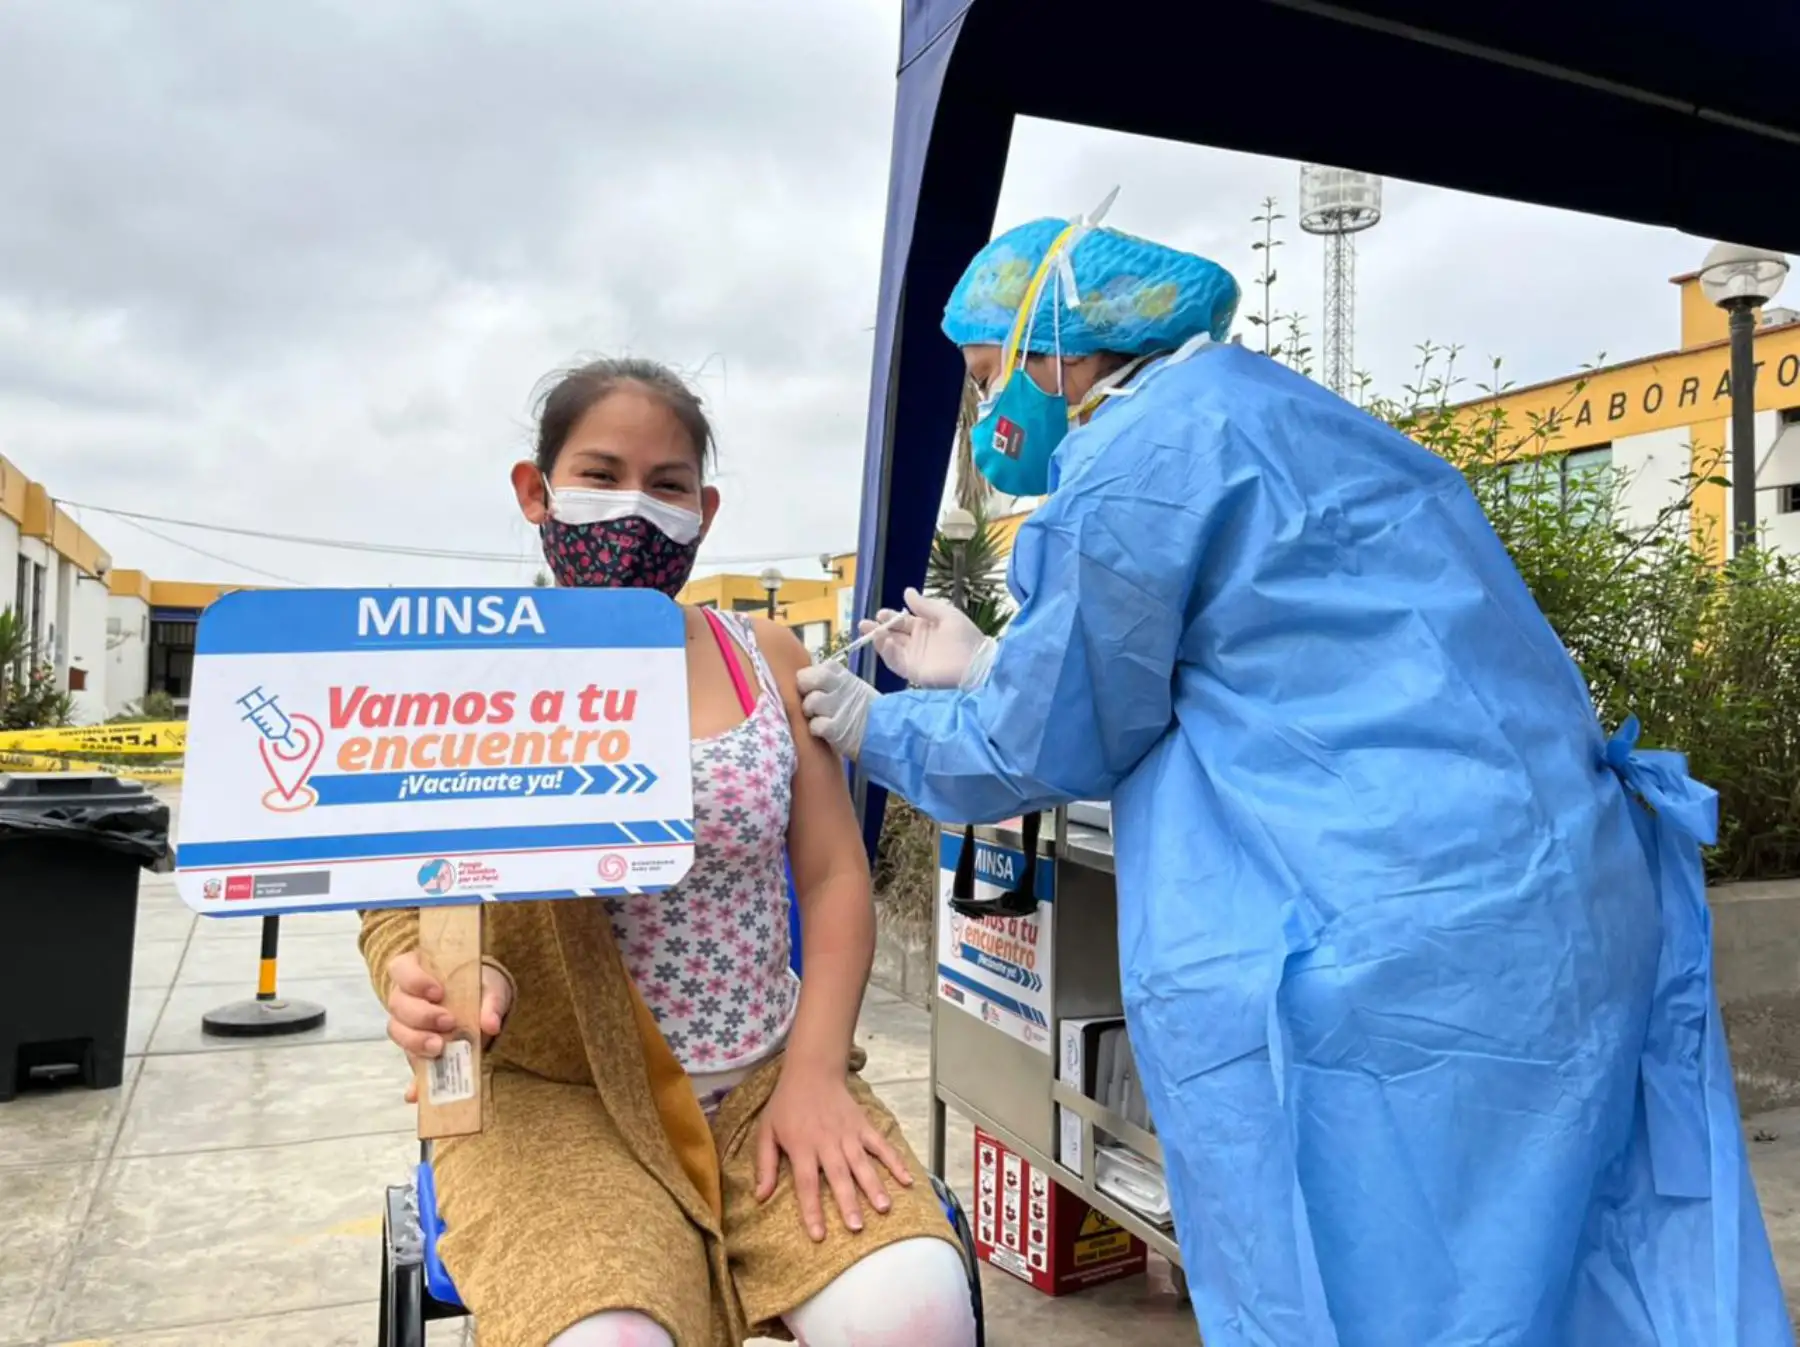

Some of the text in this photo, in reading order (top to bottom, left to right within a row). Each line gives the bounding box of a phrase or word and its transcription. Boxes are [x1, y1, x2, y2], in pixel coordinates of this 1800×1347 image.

[357, 595, 547, 636] MINSA
[328, 683, 638, 729] Vamos a tu
[336, 726, 631, 771] encuentro
[398, 770, 563, 799] ¡Vacúnate ya!
[964, 926, 1036, 970] encuentro
[1020, 918, 1039, 946] tu
